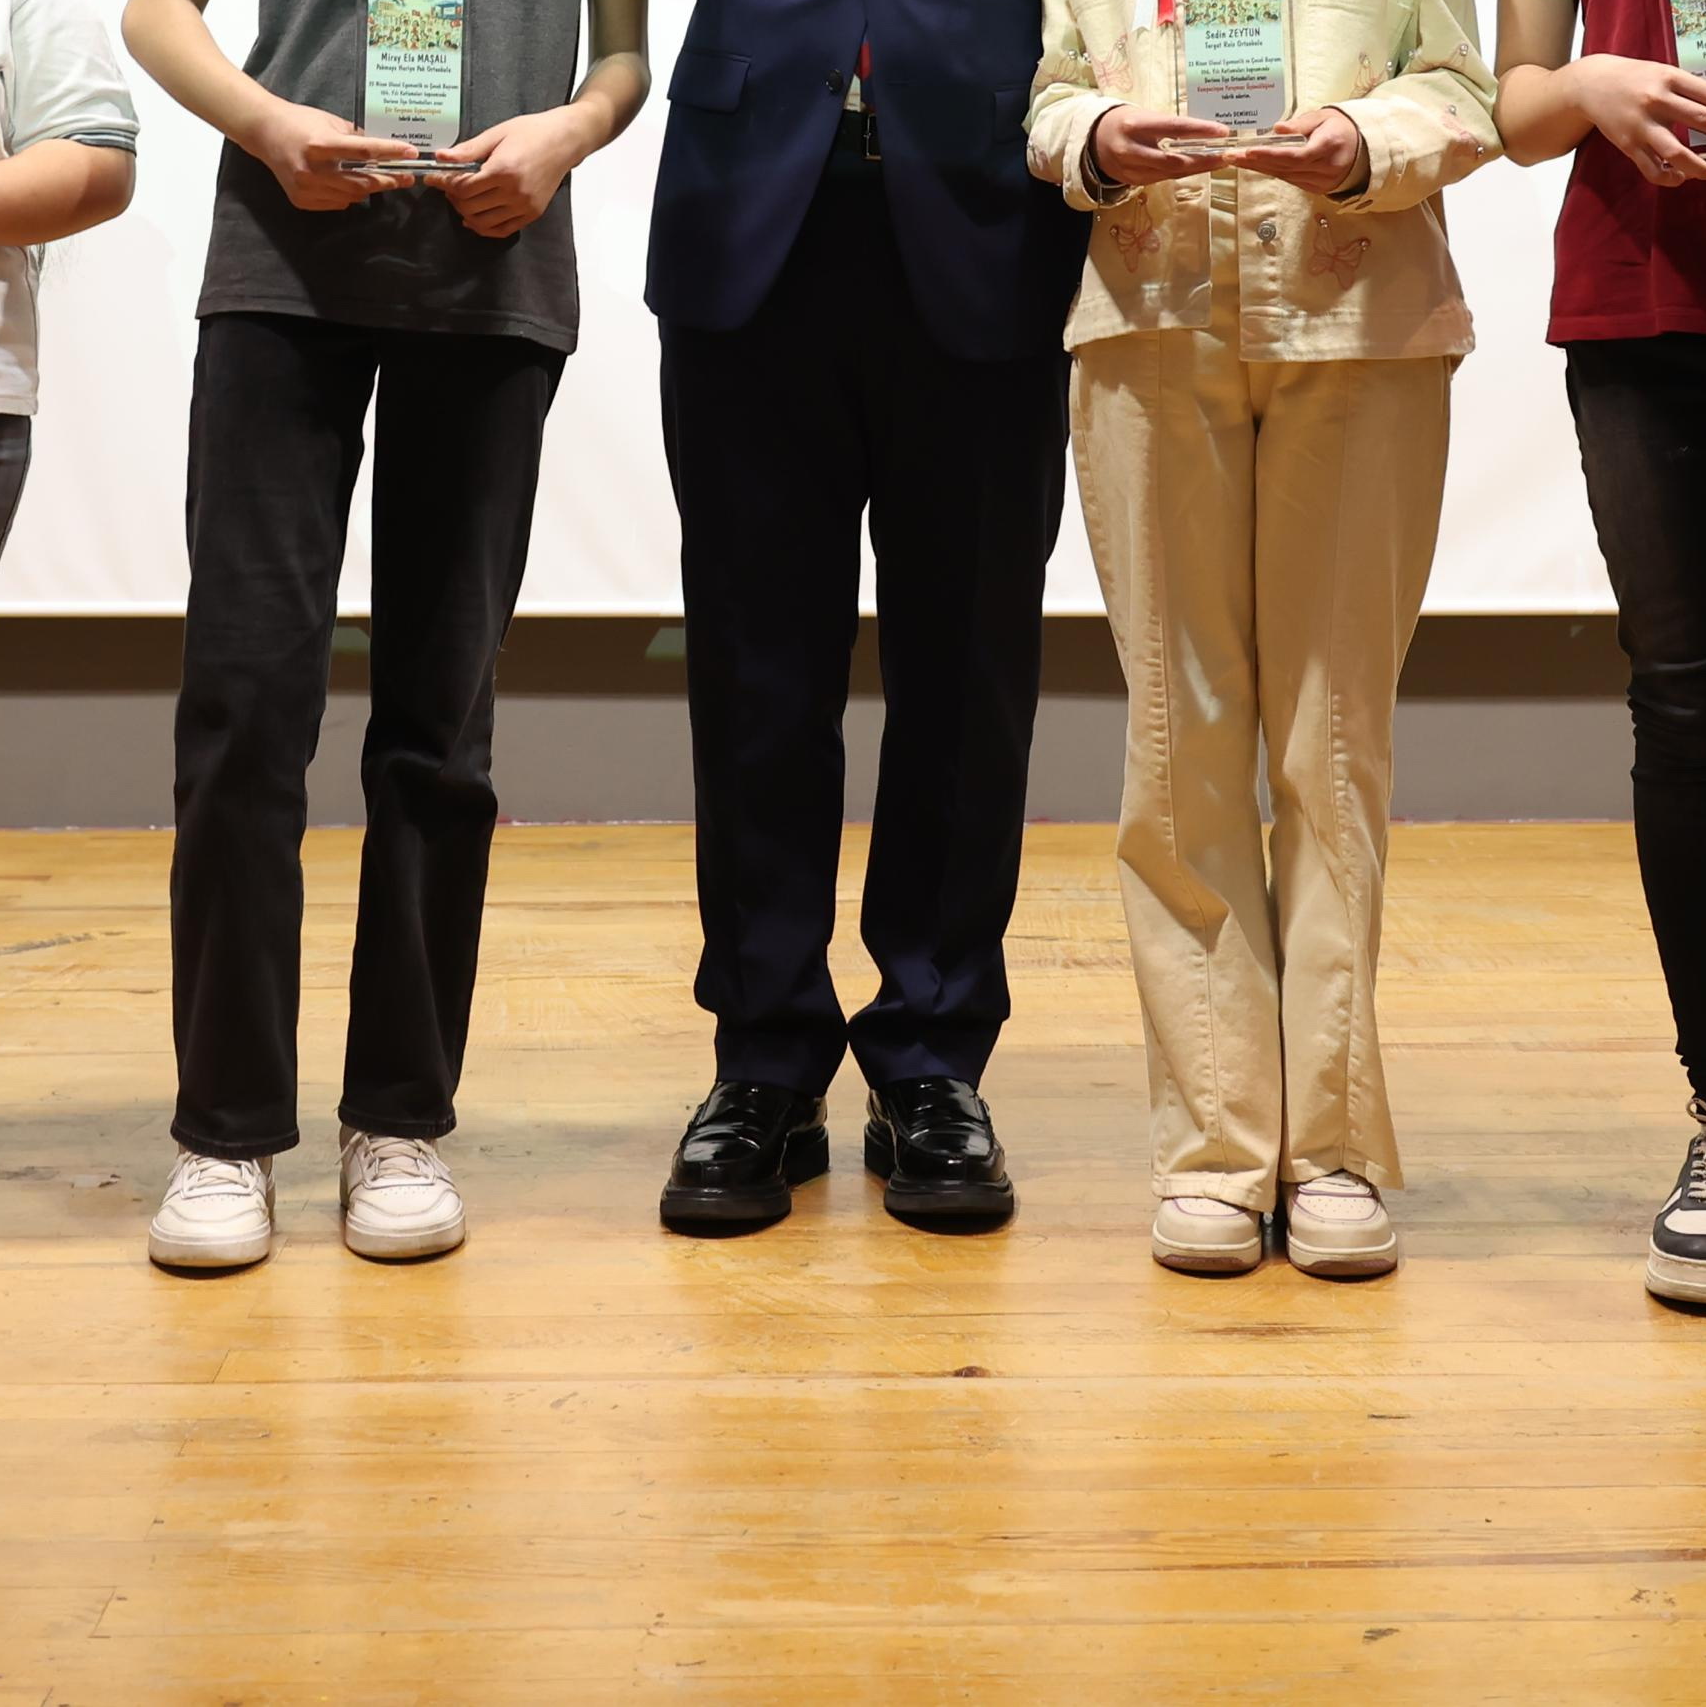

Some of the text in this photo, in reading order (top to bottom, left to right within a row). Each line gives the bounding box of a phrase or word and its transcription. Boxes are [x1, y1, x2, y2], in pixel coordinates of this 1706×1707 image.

[1229, 27, 1260, 38] ZEYTUN
[381, 53, 447, 65] Miray Ela MAŞALI
